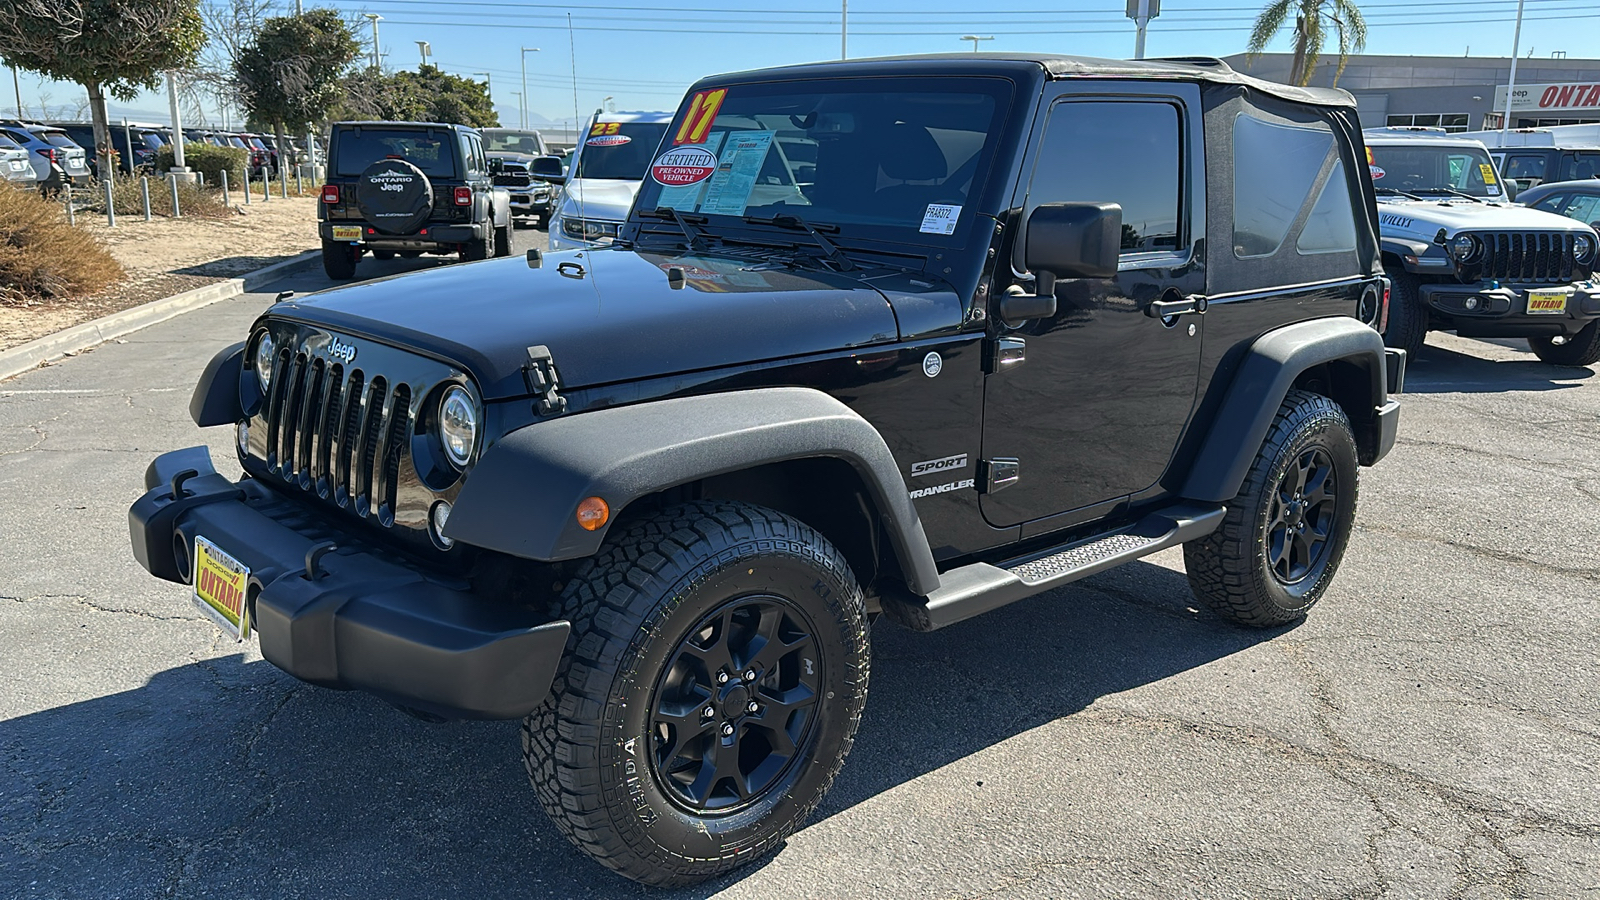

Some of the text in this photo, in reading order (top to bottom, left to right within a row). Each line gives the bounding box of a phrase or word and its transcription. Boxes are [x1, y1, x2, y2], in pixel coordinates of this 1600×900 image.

[1506, 90, 1528, 98] eep
[675, 89, 725, 144] 17
[591, 122, 620, 136] 23
[659, 154, 712, 167] CERTIFIED
[658, 167, 704, 175] PRE-OWNED
[662, 174, 695, 182] VEHICLE
[380, 183, 404, 193] Jeep
[1531, 300, 1563, 309] ONTARIO
[327, 336, 356, 365] Jeep
[915, 457, 965, 472] SPORT
[624, 736, 659, 828] KENDA
